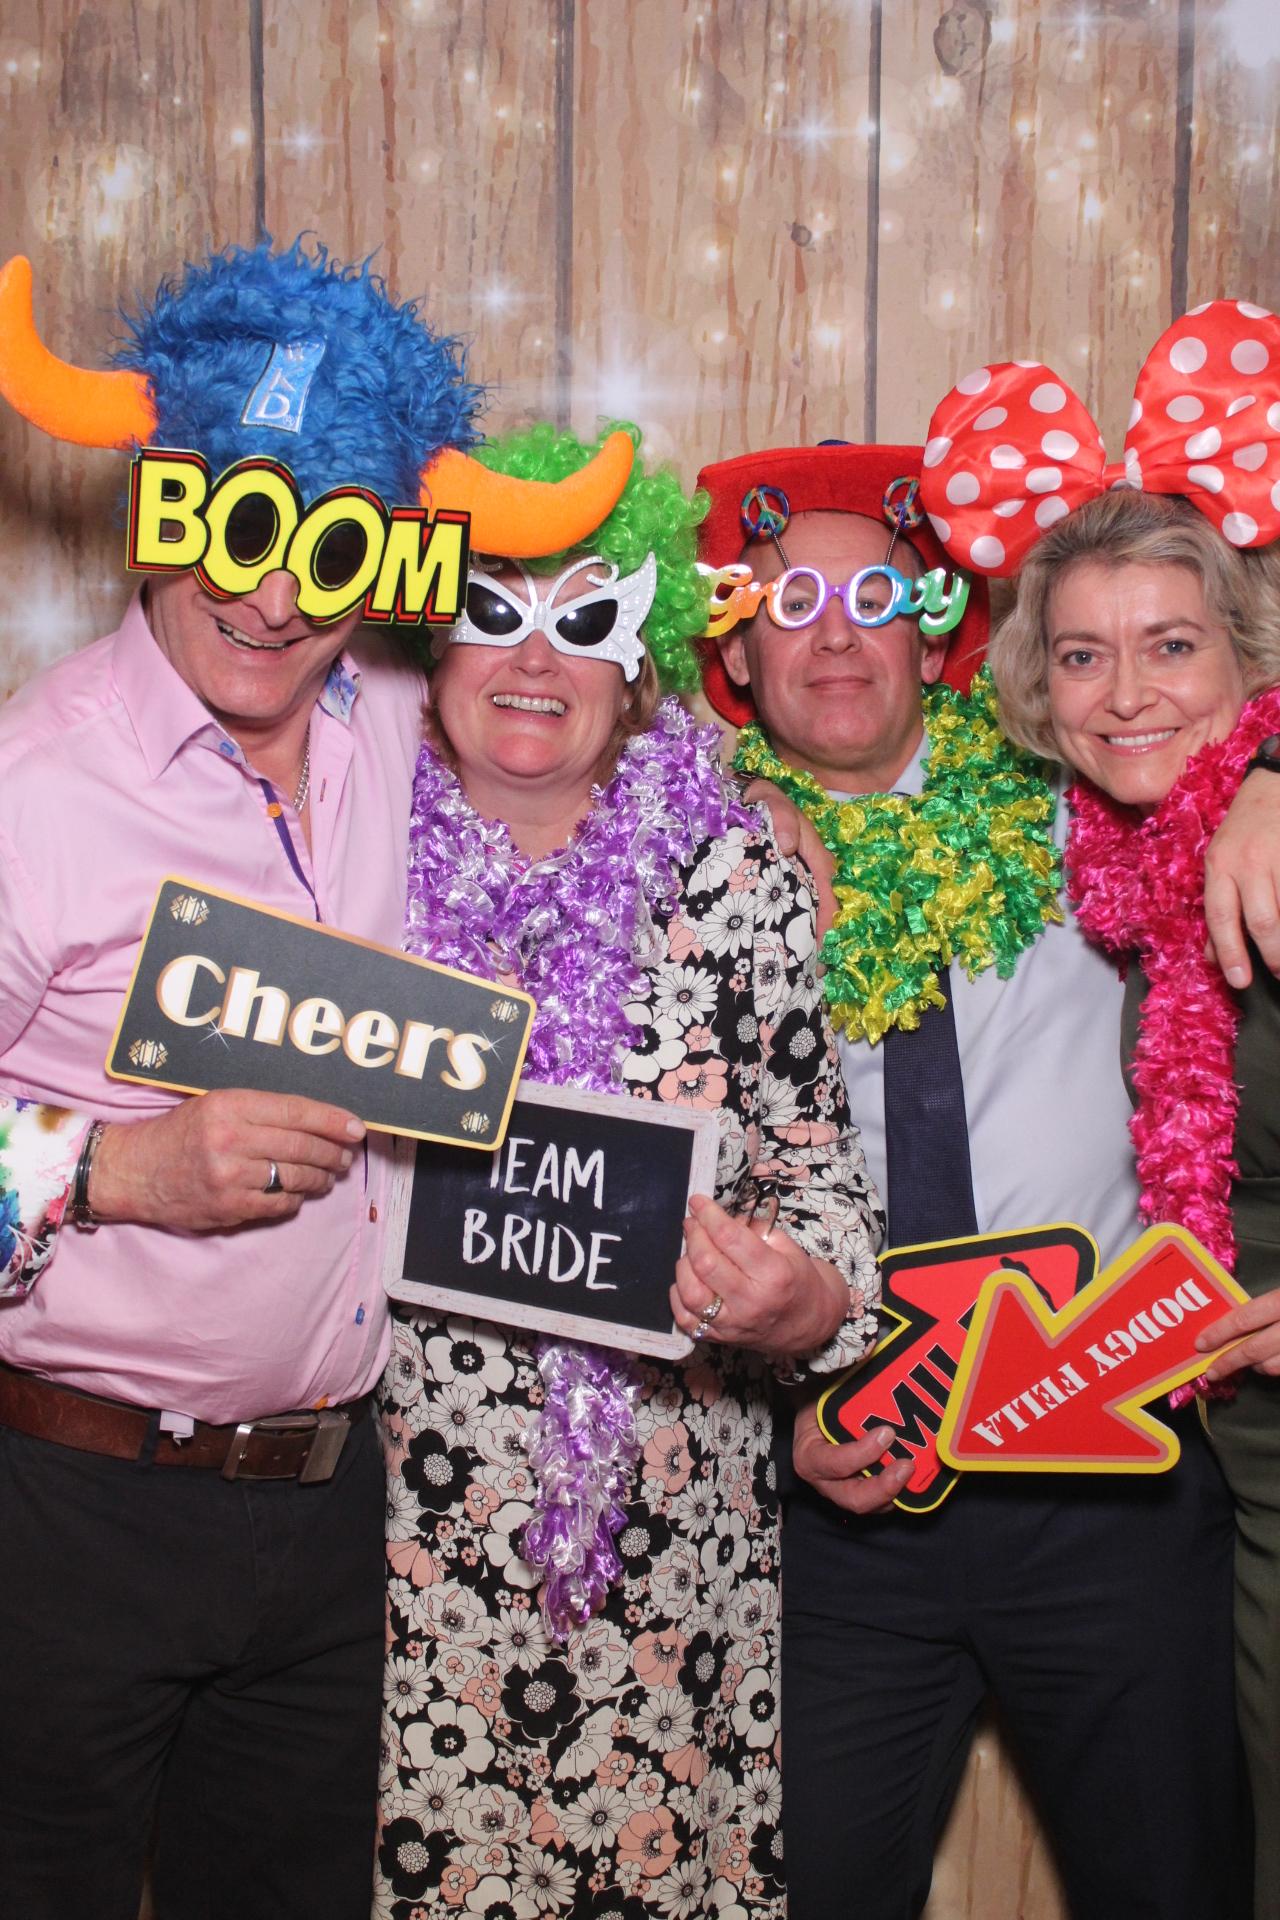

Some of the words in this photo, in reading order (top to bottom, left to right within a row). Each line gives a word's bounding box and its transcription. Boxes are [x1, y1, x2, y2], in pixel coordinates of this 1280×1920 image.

[127, 448, 470, 625] BOOM
[156, 953, 487, 1091] Cheers
[463, 1208, 622, 1290] BRIDE
[1084, 1277, 1214, 1377] DODGY
[970, 1362, 1090, 1448] FELLA
